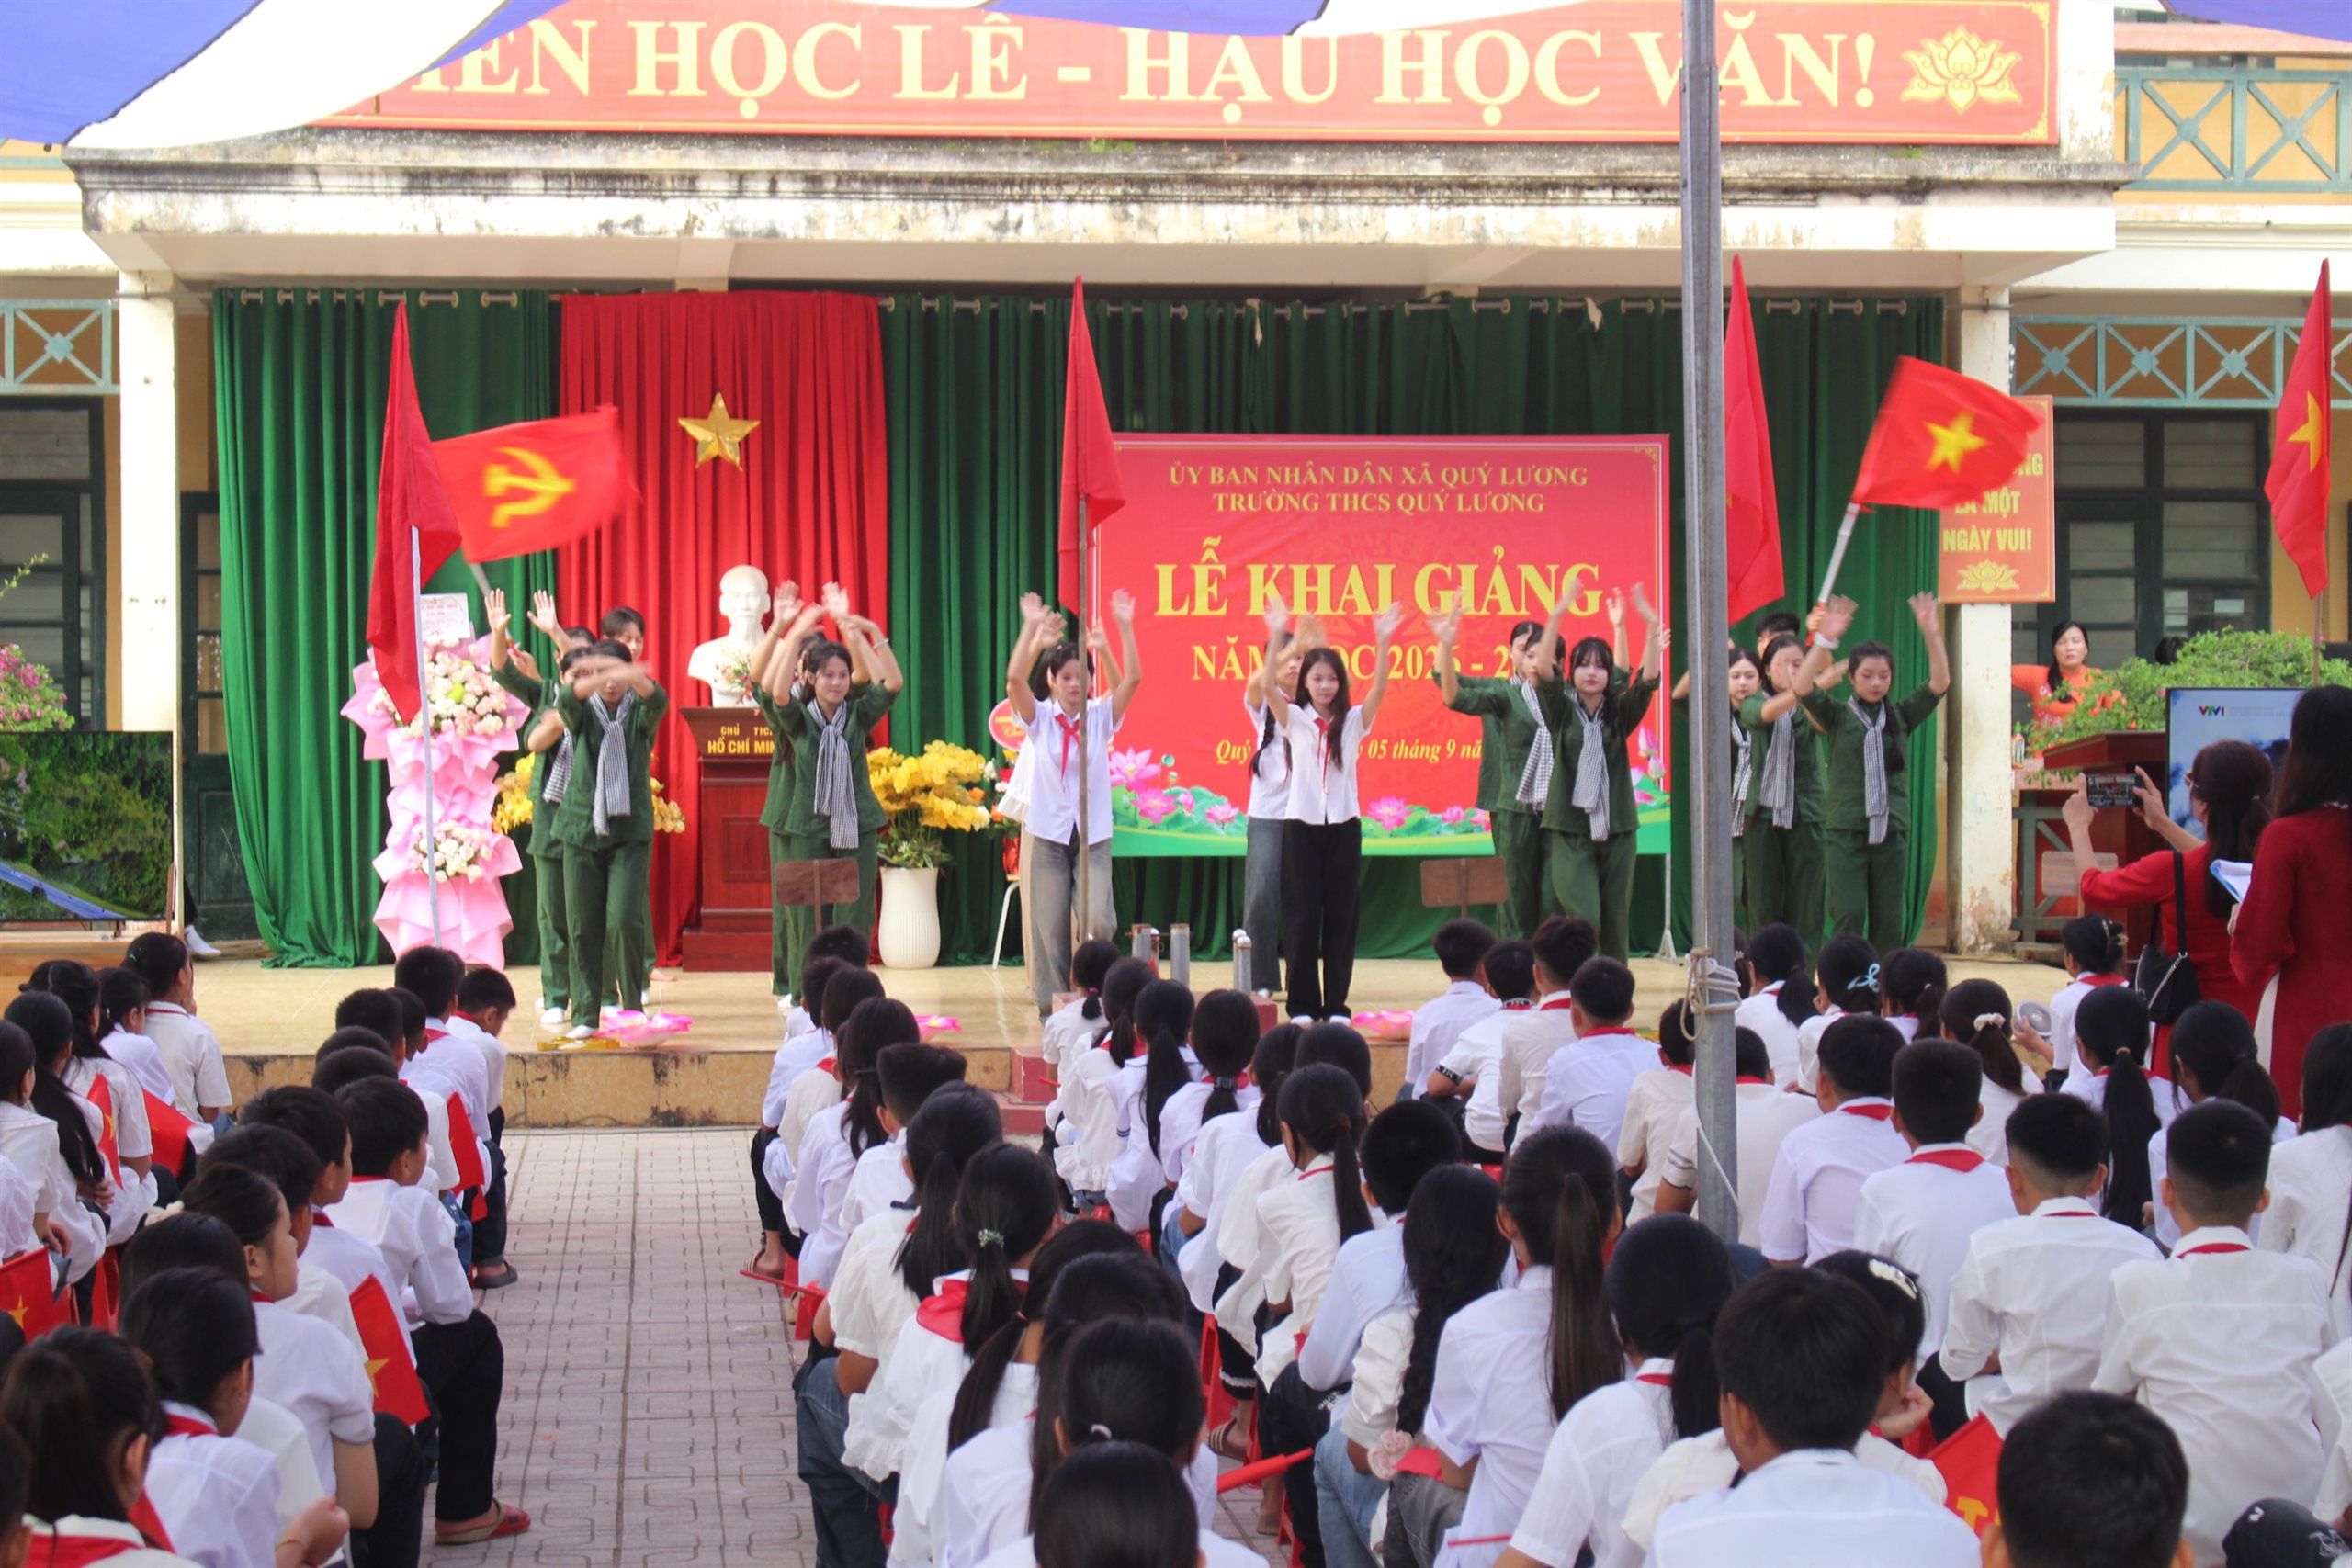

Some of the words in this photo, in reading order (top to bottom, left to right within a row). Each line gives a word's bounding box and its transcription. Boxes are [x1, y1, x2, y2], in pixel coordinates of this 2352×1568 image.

[627, 21, 862, 118] HỌC
[1057, 66, 1091, 81] -
[1374, 29, 1601, 125] HỌC
[1170, 461, 1203, 485] ỦY
[1210, 466, 1259, 485] BAN
[1266, 460, 1335, 485] NHÂN
[1343, 460, 1393, 485] DÂN
[1400, 462, 1433, 485] XÃ
[1441, 462, 1493, 489] QUÝ
[1500, 465, 1588, 485] LƯƠNG
[1213, 488, 1319, 512] TRƯỜNG
[1326, 492, 1390, 512] THCS
[1397, 488, 1449, 515] QUÝ
[1457, 491, 1544, 512] LƯƠNG
[1943, 524, 1992, 551] NGÀY
[1154, 536, 1228, 616] LỄ
[1246, 563, 1396, 615] KHAI
[1414, 545, 1603, 616] GIẢNG
[2199, 705, 2225, 716] VTV1
[720, 722, 740, 736] CHỦ
[707, 735, 725, 754] HỒ
[728, 738, 750, 754] CHÍ
[754, 740, 775, 754] MIN
[1216, 739, 1251, 765] Quý
[1368, 739, 1388, 760] 05
[1392, 739, 1441, 764] tháng
[1446, 739, 1456, 760] 9
[1460, 739, 1483, 760] nă
